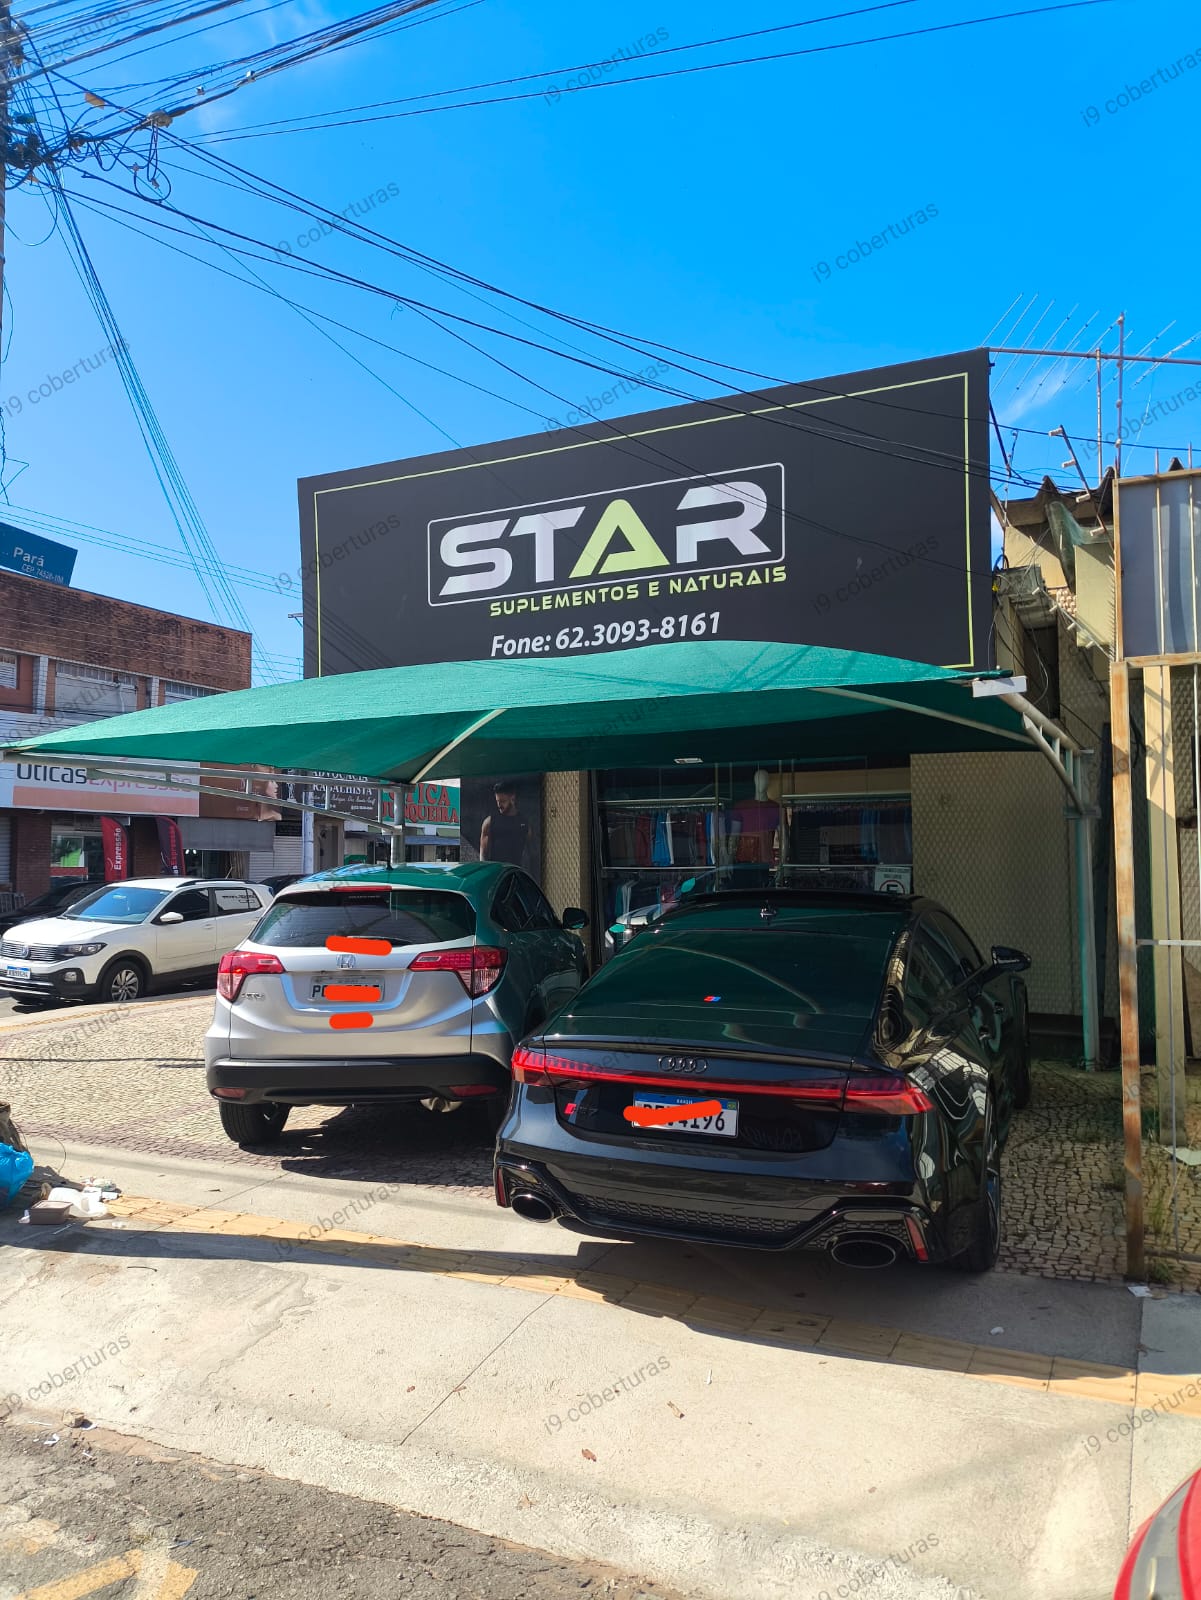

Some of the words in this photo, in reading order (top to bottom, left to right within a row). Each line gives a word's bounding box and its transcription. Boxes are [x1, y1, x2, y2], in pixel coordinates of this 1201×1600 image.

[13, 546, 45, 567] Pará
[439, 481, 772, 596] STAR
[489, 584, 639, 617] SUPLEMENTOS
[648, 581, 660, 597] E
[669, 565, 787, 594] NATURAIS
[491, 632, 551, 657] Fone:
[555, 611, 721, 650] 62.3093-8161
